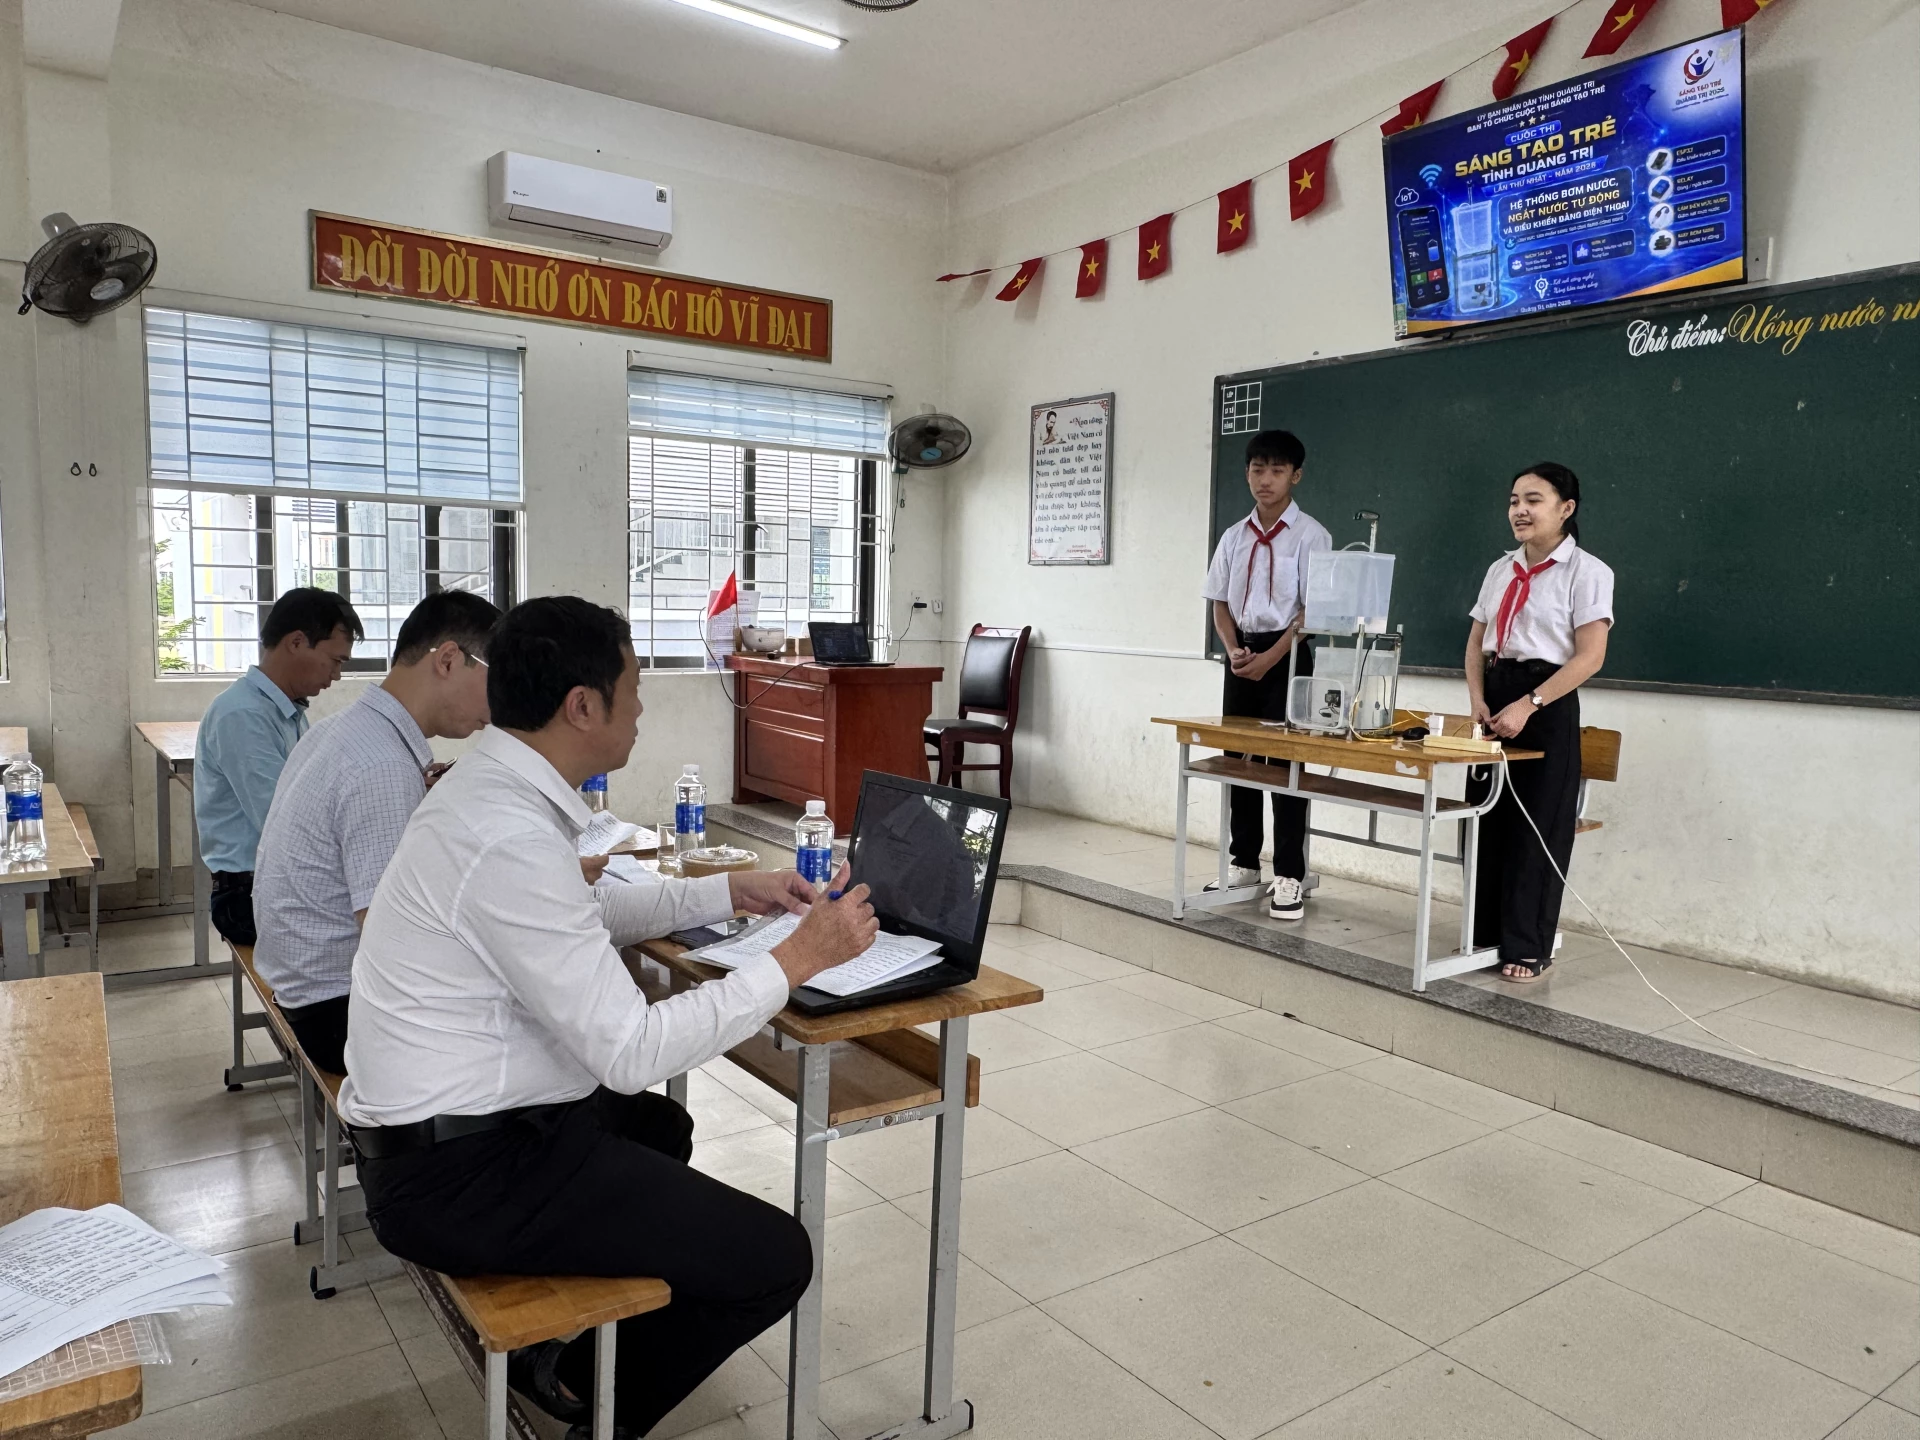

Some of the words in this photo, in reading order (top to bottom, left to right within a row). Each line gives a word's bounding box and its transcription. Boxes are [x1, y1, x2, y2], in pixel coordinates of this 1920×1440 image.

[1467, 124, 1482, 133] BAN
[1537, 102, 1549, 112] THI
[1573, 90, 1588, 102] TẠO
[1487, 108, 1501, 119] BAN
[1502, 102, 1522, 115] NHÂN
[1523, 98, 1537, 108] DÂN
[1540, 124, 1555, 134] THI
[1455, 148, 1512, 177] SÁNG
[1517, 133, 1564, 159] TẠO
[1569, 114, 1617, 146] TRẺ
[1482, 168, 1514, 184] TỈNH
[1517, 152, 1567, 174] QUẢNG
[1570, 145, 1594, 161] TRỊ
[1510, 199, 1523, 212] HỆ
[1525, 189, 1559, 207] THỐNG
[1561, 184, 1585, 198] BƠM
[1538, 200, 1569, 217] NƯỚC
[1571, 198, 1587, 210] TỰ
[1588, 190, 1620, 205] ĐỘNG
[1503, 223, 1513, 234] VÀ
[339, 230, 404, 290] ĐỜI
[418, 242, 478, 302] ĐỜI
[490, 259, 562, 312] NHỚ
[568, 272, 612, 322] ƠN
[621, 276, 678, 332] BÁC
[684, 286, 724, 338] HỒ
[730, 296, 760, 344] VĨ
[766, 306, 814, 354] ĐẠI
[1626, 319, 1668, 356] Chủ
[1671, 314, 1726, 350] điểm:
[1728, 303, 1814, 356] Uống
[1819, 297, 1886, 332] nước
[1077, 444, 1088, 452] đẹp
